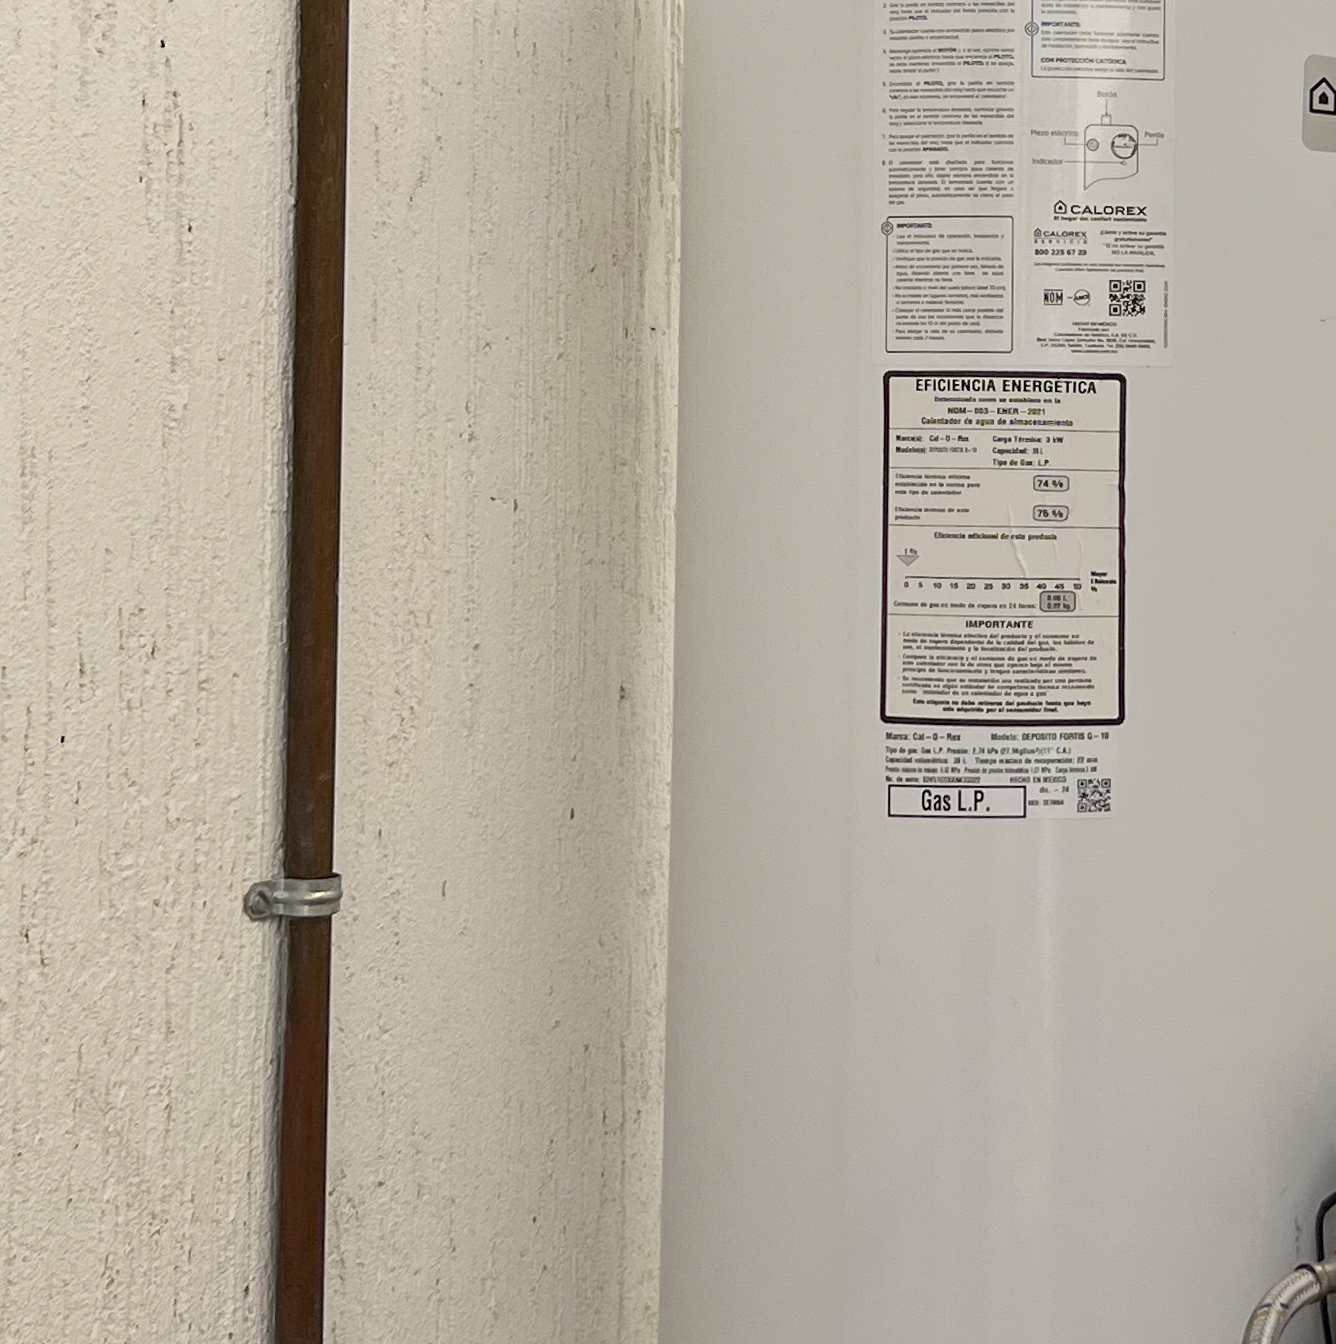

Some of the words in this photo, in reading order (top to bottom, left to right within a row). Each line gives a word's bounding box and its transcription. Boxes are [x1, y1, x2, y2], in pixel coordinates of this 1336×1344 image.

[1071, 205, 1147, 216] CALOREX
[1043, 230, 1088, 238] CALOREX
[916, 378, 996, 392] EFICIENCIA
[1002, 378, 1097, 394] ENERGÉTICA
[965, 620, 1034, 629] IMPORTANTE
[921, 789, 951, 811] Gas
[958, 789, 990, 812] L.P.
